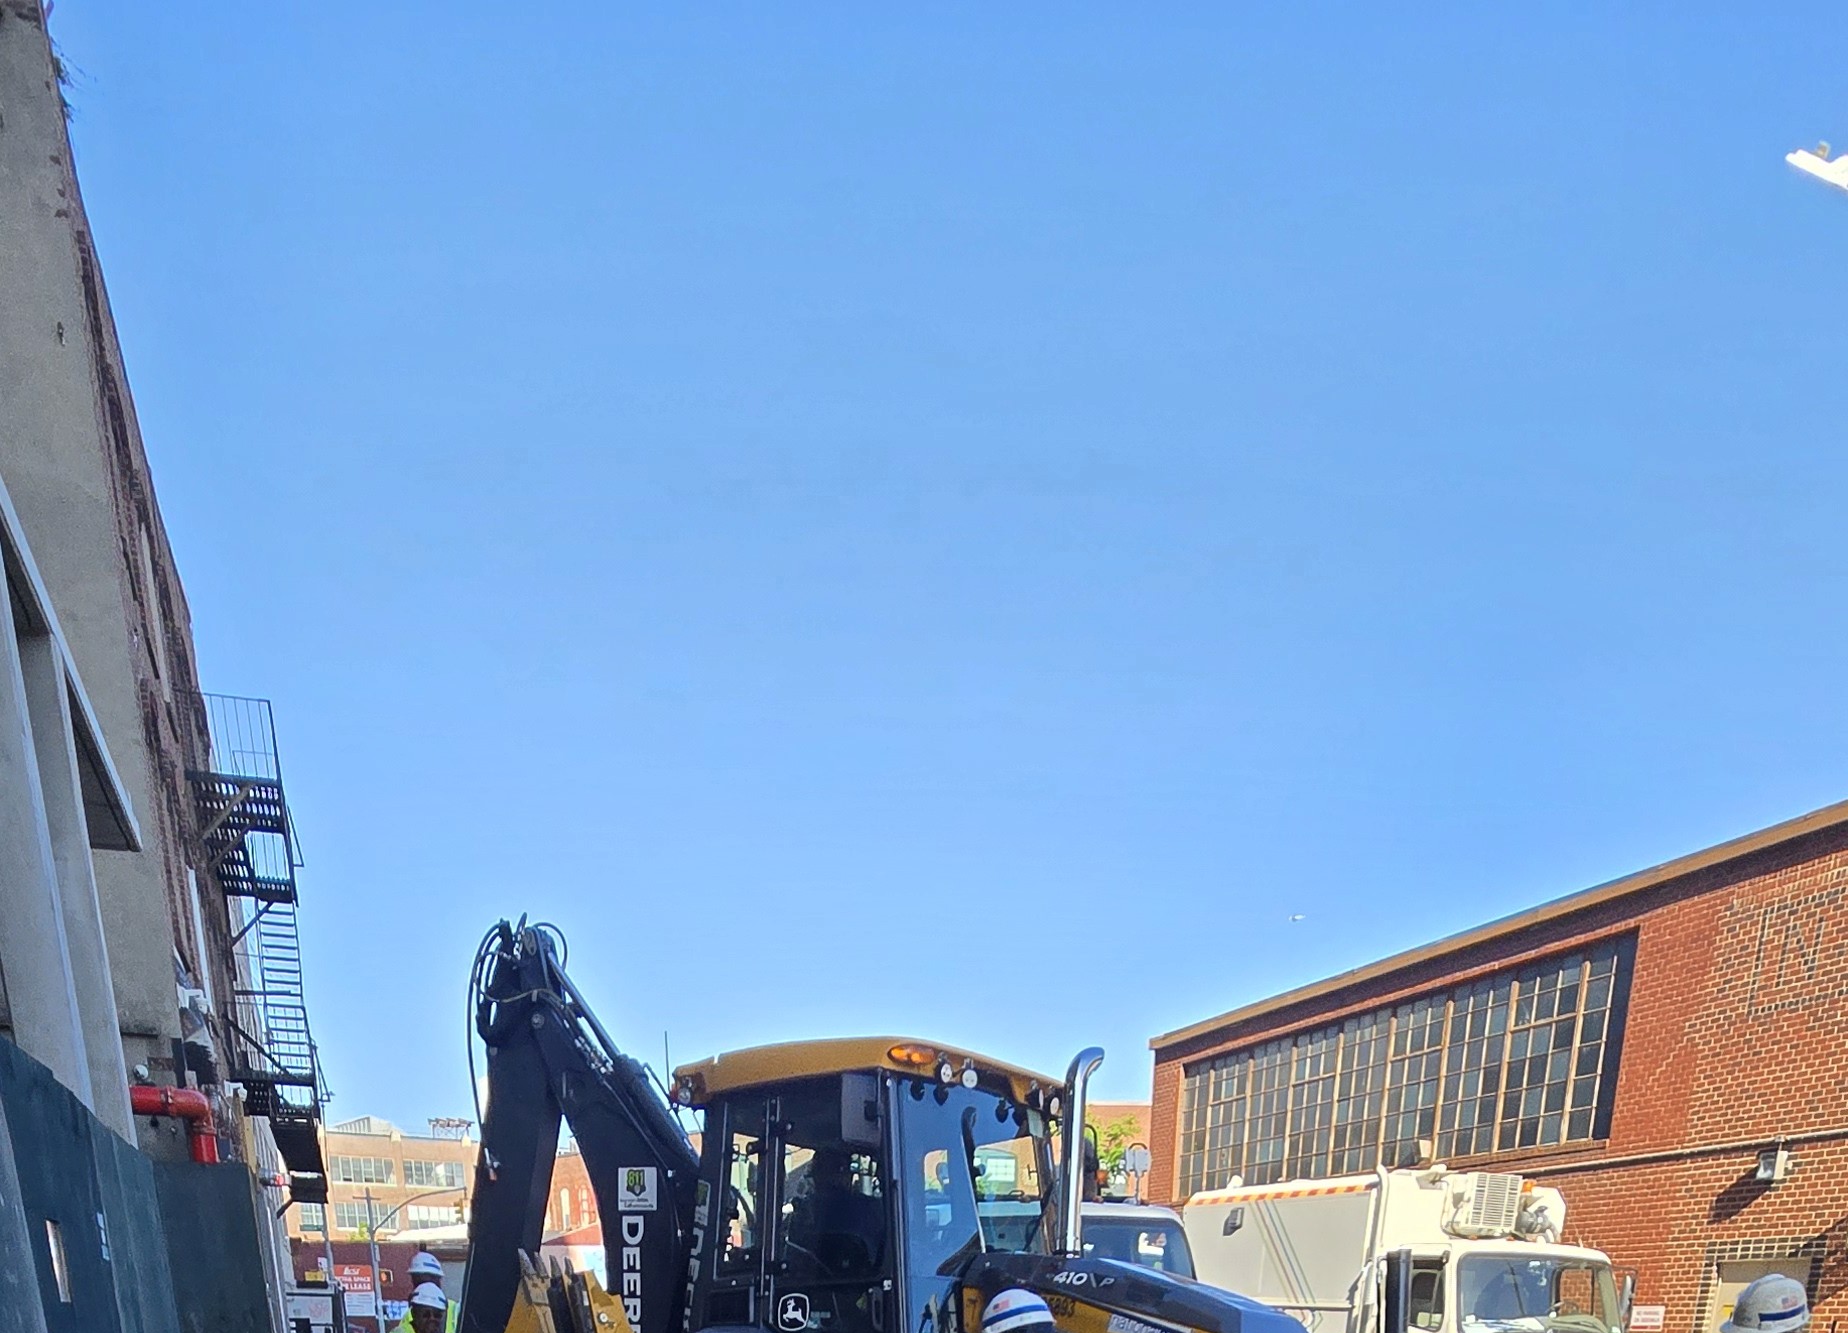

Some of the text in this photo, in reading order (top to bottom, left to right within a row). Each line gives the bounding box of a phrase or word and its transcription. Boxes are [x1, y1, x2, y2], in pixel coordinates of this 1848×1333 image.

[627, 1170, 645, 1187] 811
[1053, 1271, 1088, 1286] 410
[351, 1283, 371, 1291] LEASE
